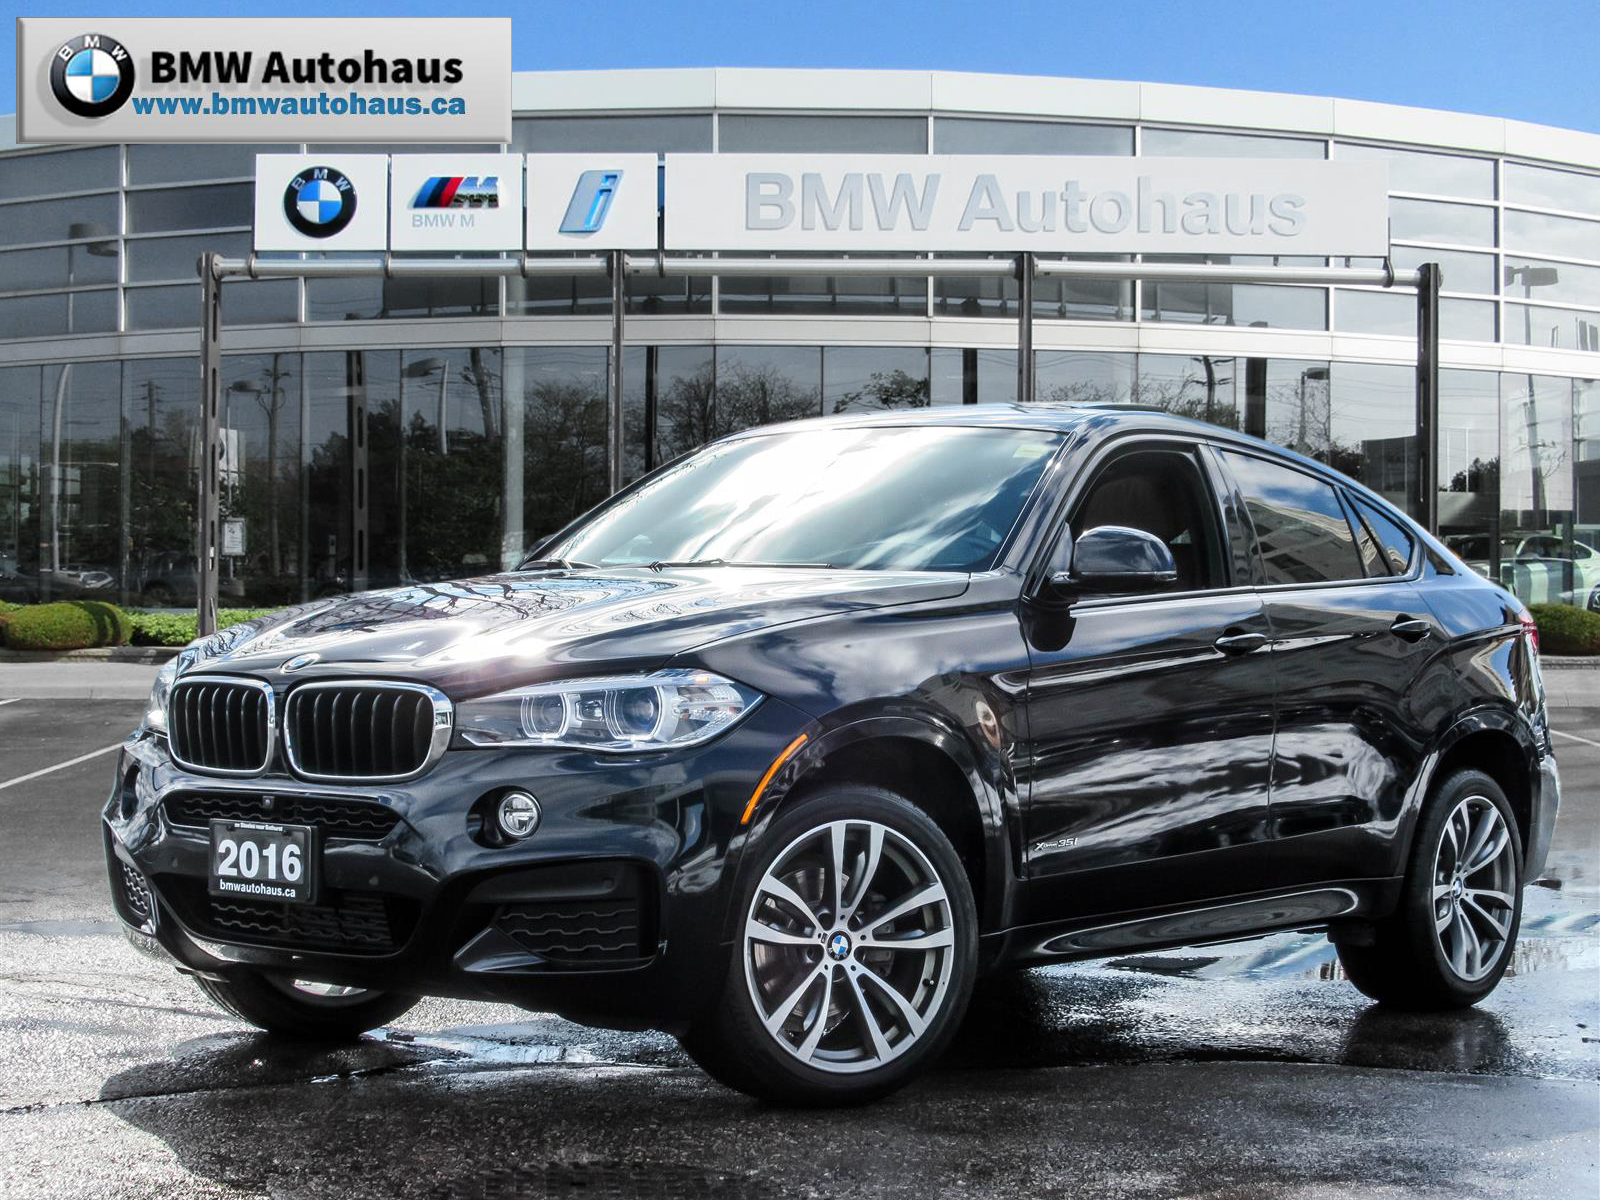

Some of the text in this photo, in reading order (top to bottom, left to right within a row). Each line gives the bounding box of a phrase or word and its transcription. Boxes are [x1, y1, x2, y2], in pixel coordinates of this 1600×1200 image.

[745, 172, 1307, 237] BMW Autohaus
[412, 214, 475, 228] BMW M
[218, 839, 301, 882] 2016
[219, 878, 296, 898] bmwautohaus.ca
